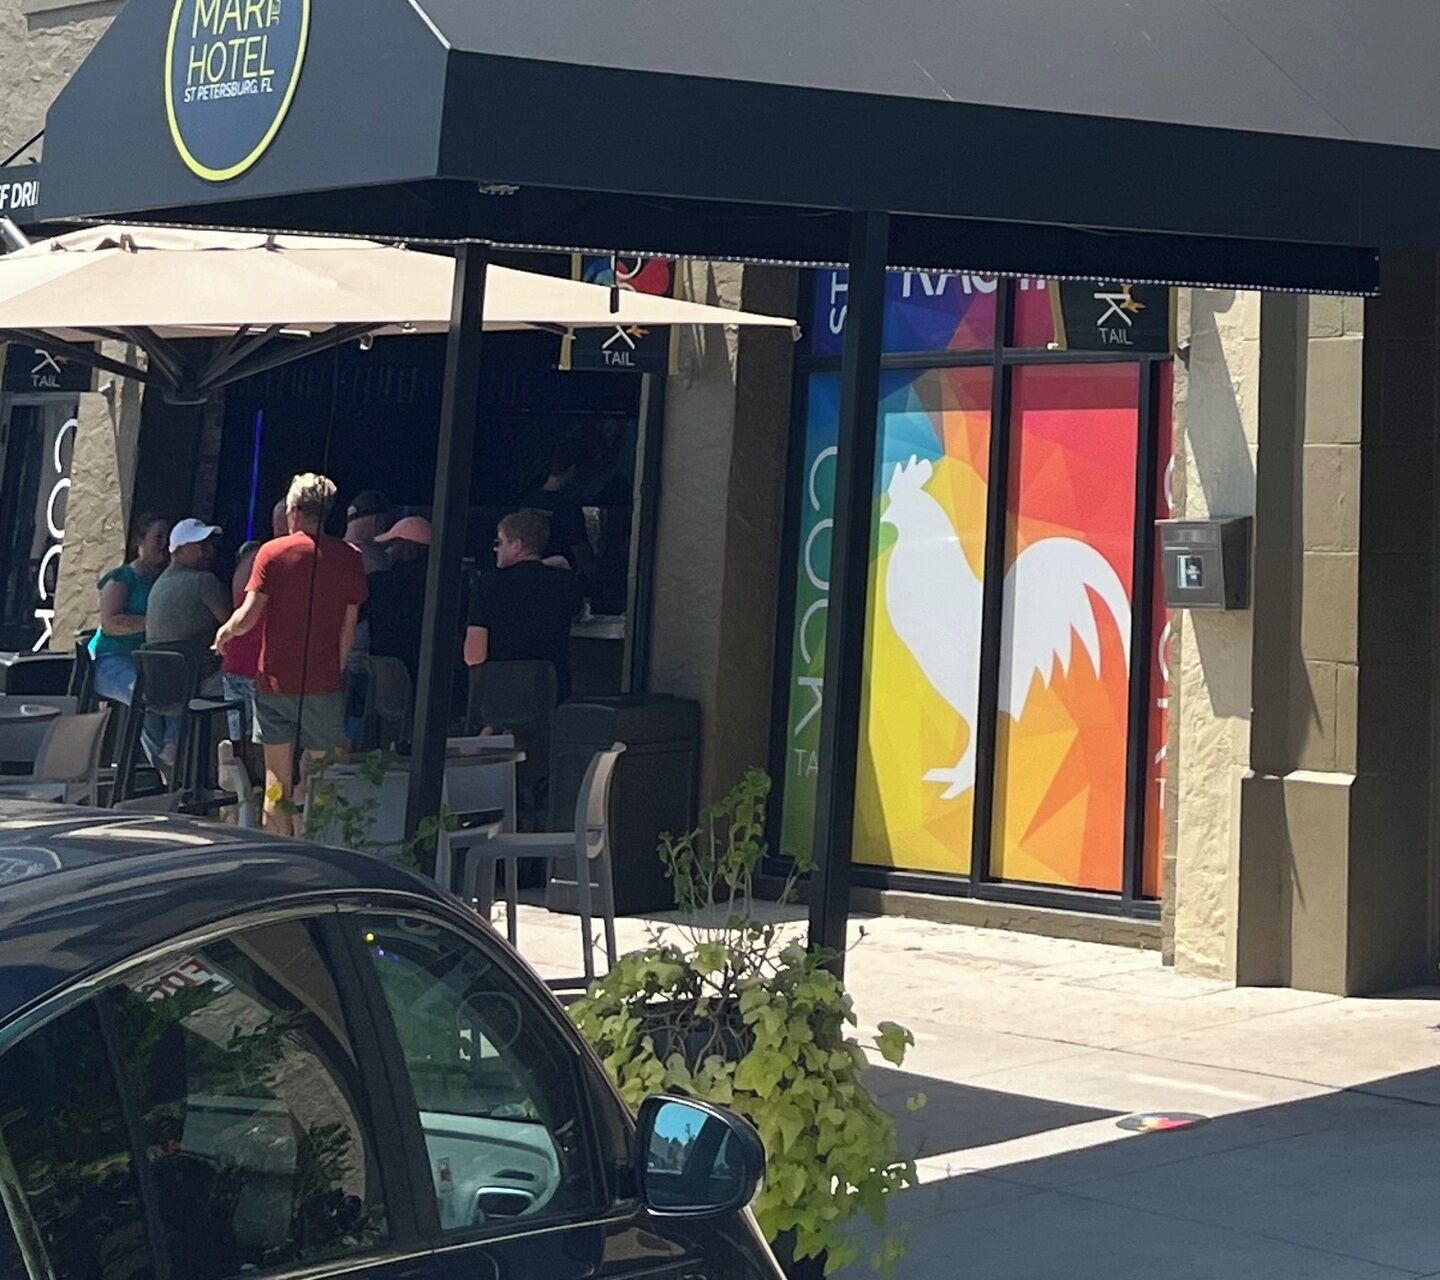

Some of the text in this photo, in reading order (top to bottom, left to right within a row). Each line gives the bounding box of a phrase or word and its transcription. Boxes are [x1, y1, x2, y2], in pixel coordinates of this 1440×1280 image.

[186, 34, 276, 86] HOTEL
[183, 85, 197, 103] ST
[260, 76, 274, 93] FL
[1093, 327, 1134, 345] TAIL
[601, 350, 636, 366] TAIL
[31, 375, 61, 388] TAIL
